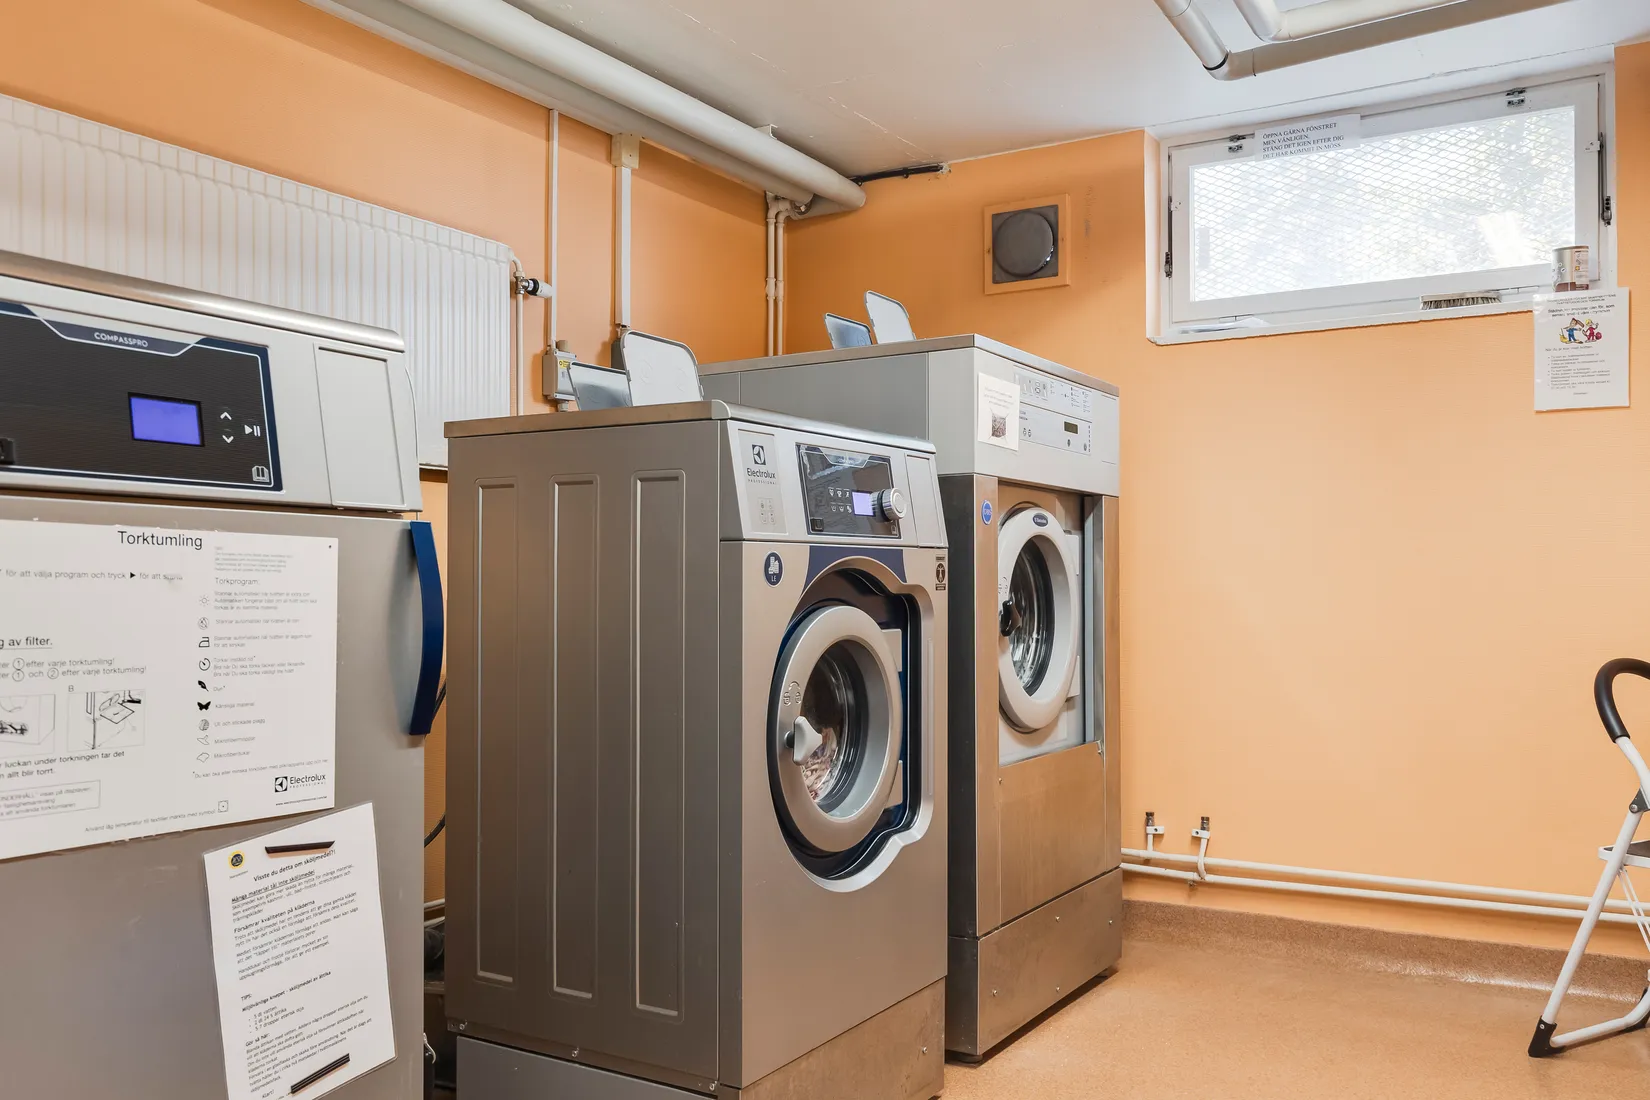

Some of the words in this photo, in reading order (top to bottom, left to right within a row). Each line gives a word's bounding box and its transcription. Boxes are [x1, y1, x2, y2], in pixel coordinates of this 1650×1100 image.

[1306, 123, 1337, 132] FÖNSTRET
[1263, 144, 1282, 152] STÄNG
[1290, 146, 1314, 155] KOMMIT
[94, 332, 148, 348] COMPASSPRO
[747, 468, 776, 478] Electrolux
[118, 530, 202, 550] Torktumling
[6, 569, 16, 577] för
[108, 572, 126, 580] tryck
[26, 636, 52, 646] filter.
[26, 660, 44, 668] efter
[48, 660, 66, 668] varje
[69, 658, 114, 666] torktumling!
[102, 666, 146, 674] torktumling!
[5, 760, 32, 768] luckan
[60, 754, 99, 763] torkningen
[290, 774, 326, 784] Electrolux
[254, 872, 270, 881] Visste
[232, 893, 247, 903] Många
[248, 886, 269, 896] material
[289, 870, 315, 882] sköljmedel
[234, 920, 260, 932] Försämrar
[261, 911, 286, 922] kvaliteten
[294, 900, 315, 910] kläderna
[270, 990, 285, 1001] knepet
[289, 979, 312, 992] sköljmedel
[263, 1006, 277, 1014] vatten
